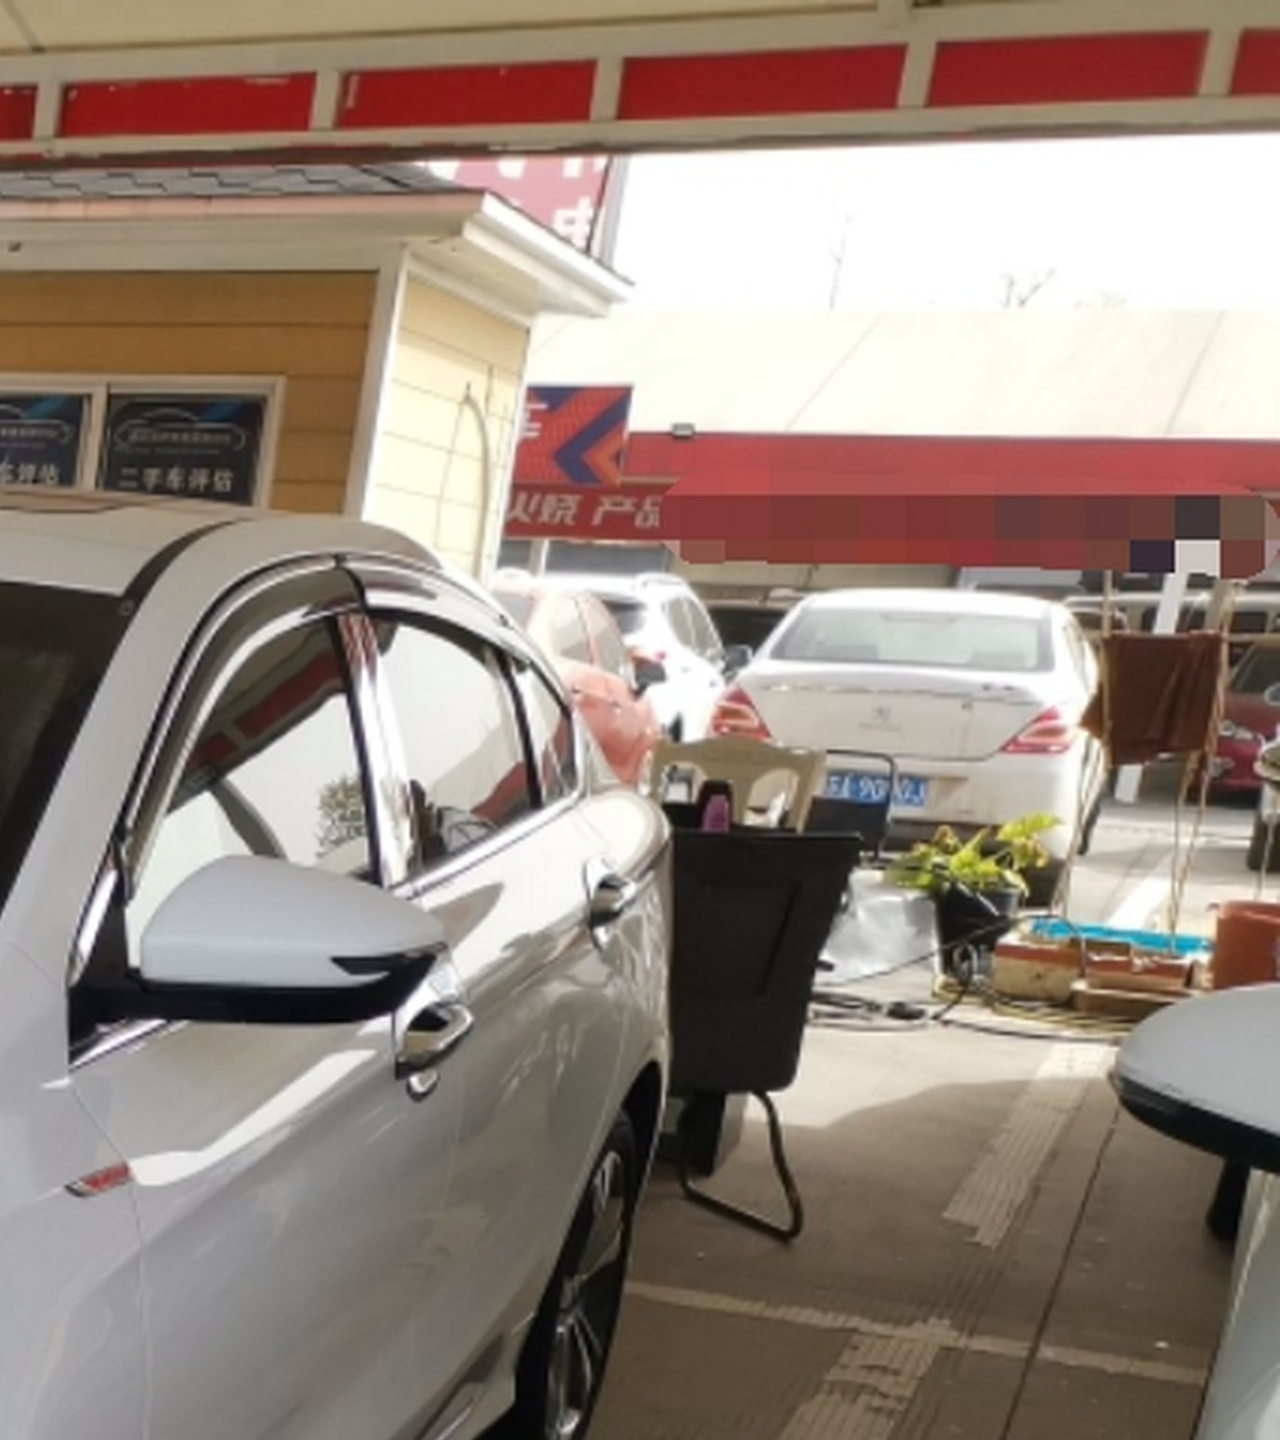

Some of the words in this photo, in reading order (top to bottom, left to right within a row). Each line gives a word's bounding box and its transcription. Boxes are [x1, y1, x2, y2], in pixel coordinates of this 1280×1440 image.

[117, 464, 235, 493] 二手车评估
